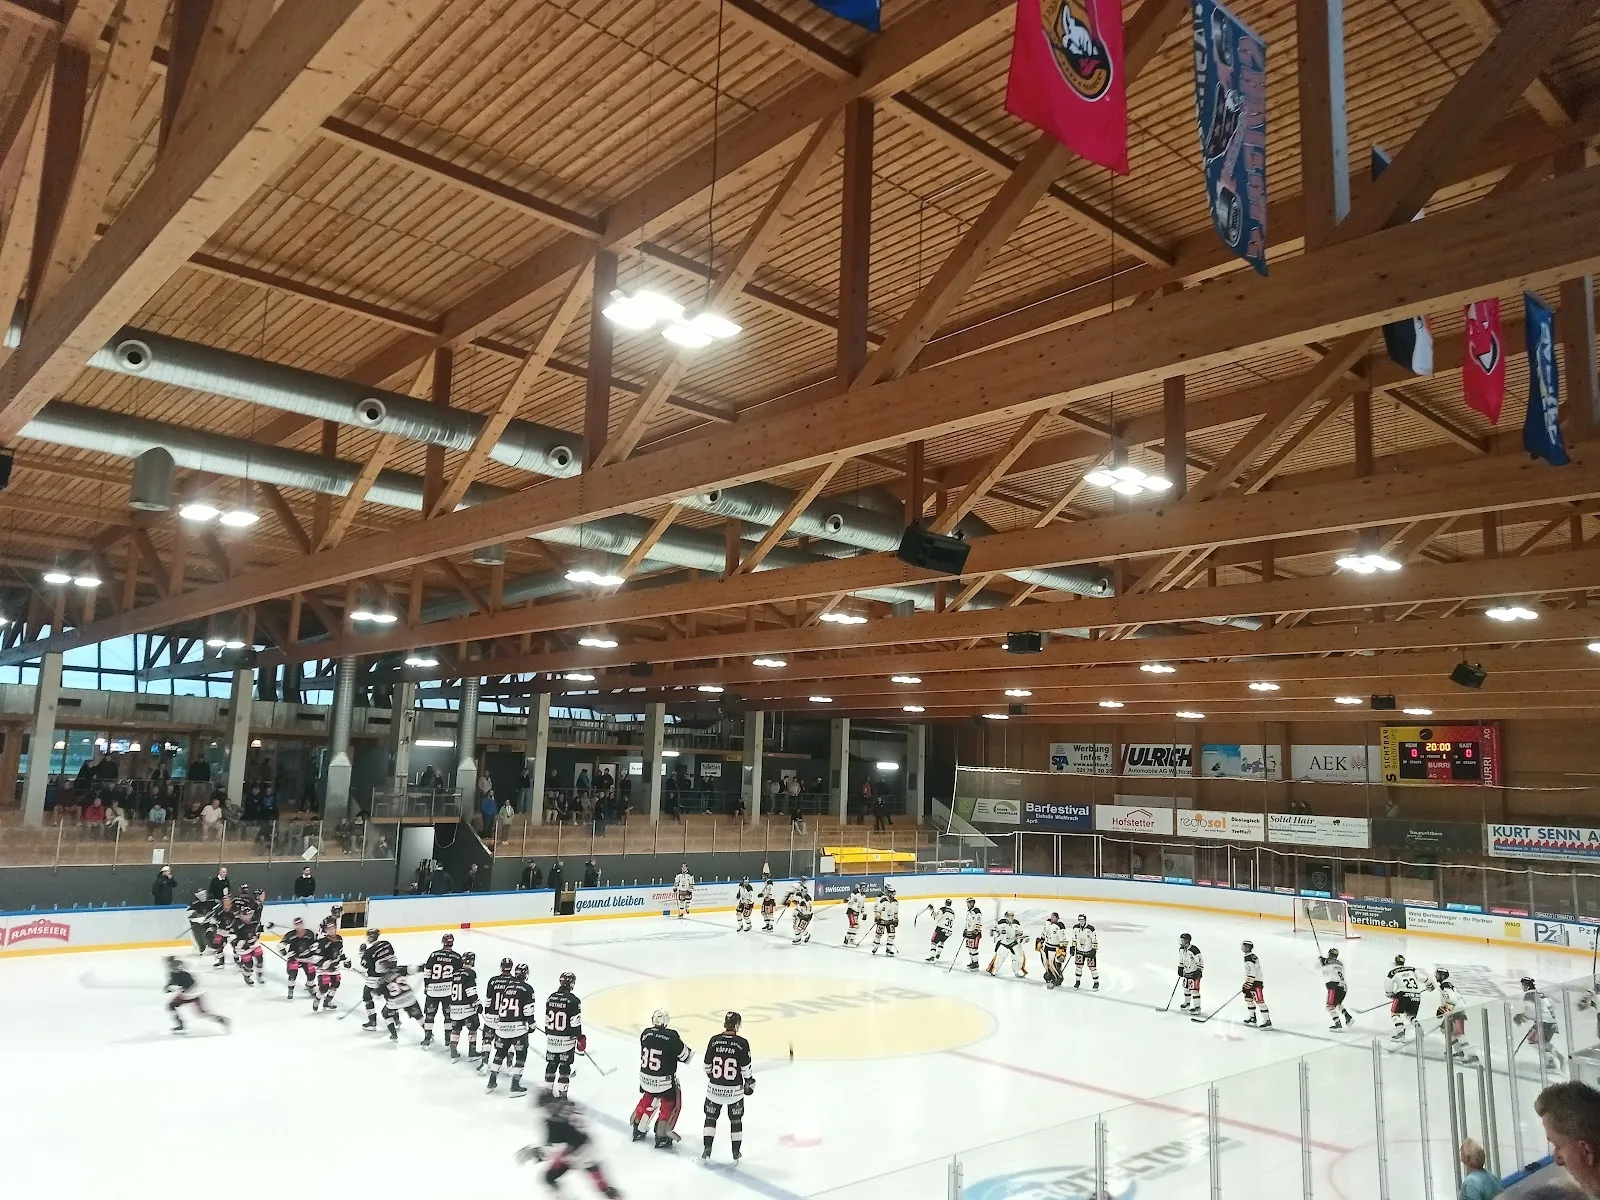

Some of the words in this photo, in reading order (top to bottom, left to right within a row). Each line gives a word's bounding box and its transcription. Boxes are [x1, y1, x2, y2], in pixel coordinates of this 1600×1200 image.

[1073, 744, 1109, 754] Werbung
[1426, 743, 1451, 751] 20:00
[1080, 753, 1101, 761] Infos
[1128, 747, 1192, 767] ULRICH
[1310, 756, 1347, 771] AEK
[1483, 756, 1493, 786] BURRI
[1026, 802, 1089, 816] Barfestival
[1112, 817, 1155, 828] Hofstetter
[1270, 815, 1292, 824] Solid
[1293, 816, 1316, 825] Hair
[1493, 826, 1530, 839] KURT
[1538, 828, 1580, 841] SENN
[1588, 831, 1600, 842] A
[825, 885, 850, 893] swisscom
[576, 898, 611, 912] gesund
[613, 896, 644, 907] bleiben
[11, 926, 67, 940] RAMSEIER
[432, 964, 453, 979] 92
[1403, 978, 1418, 989] 23
[452, 983, 463, 1001] 91
[499, 997, 519, 1018] 24
[547, 1010, 567, 1031] 20
[642, 1047, 662, 1071] 35
[712, 1056, 737, 1081] 66
